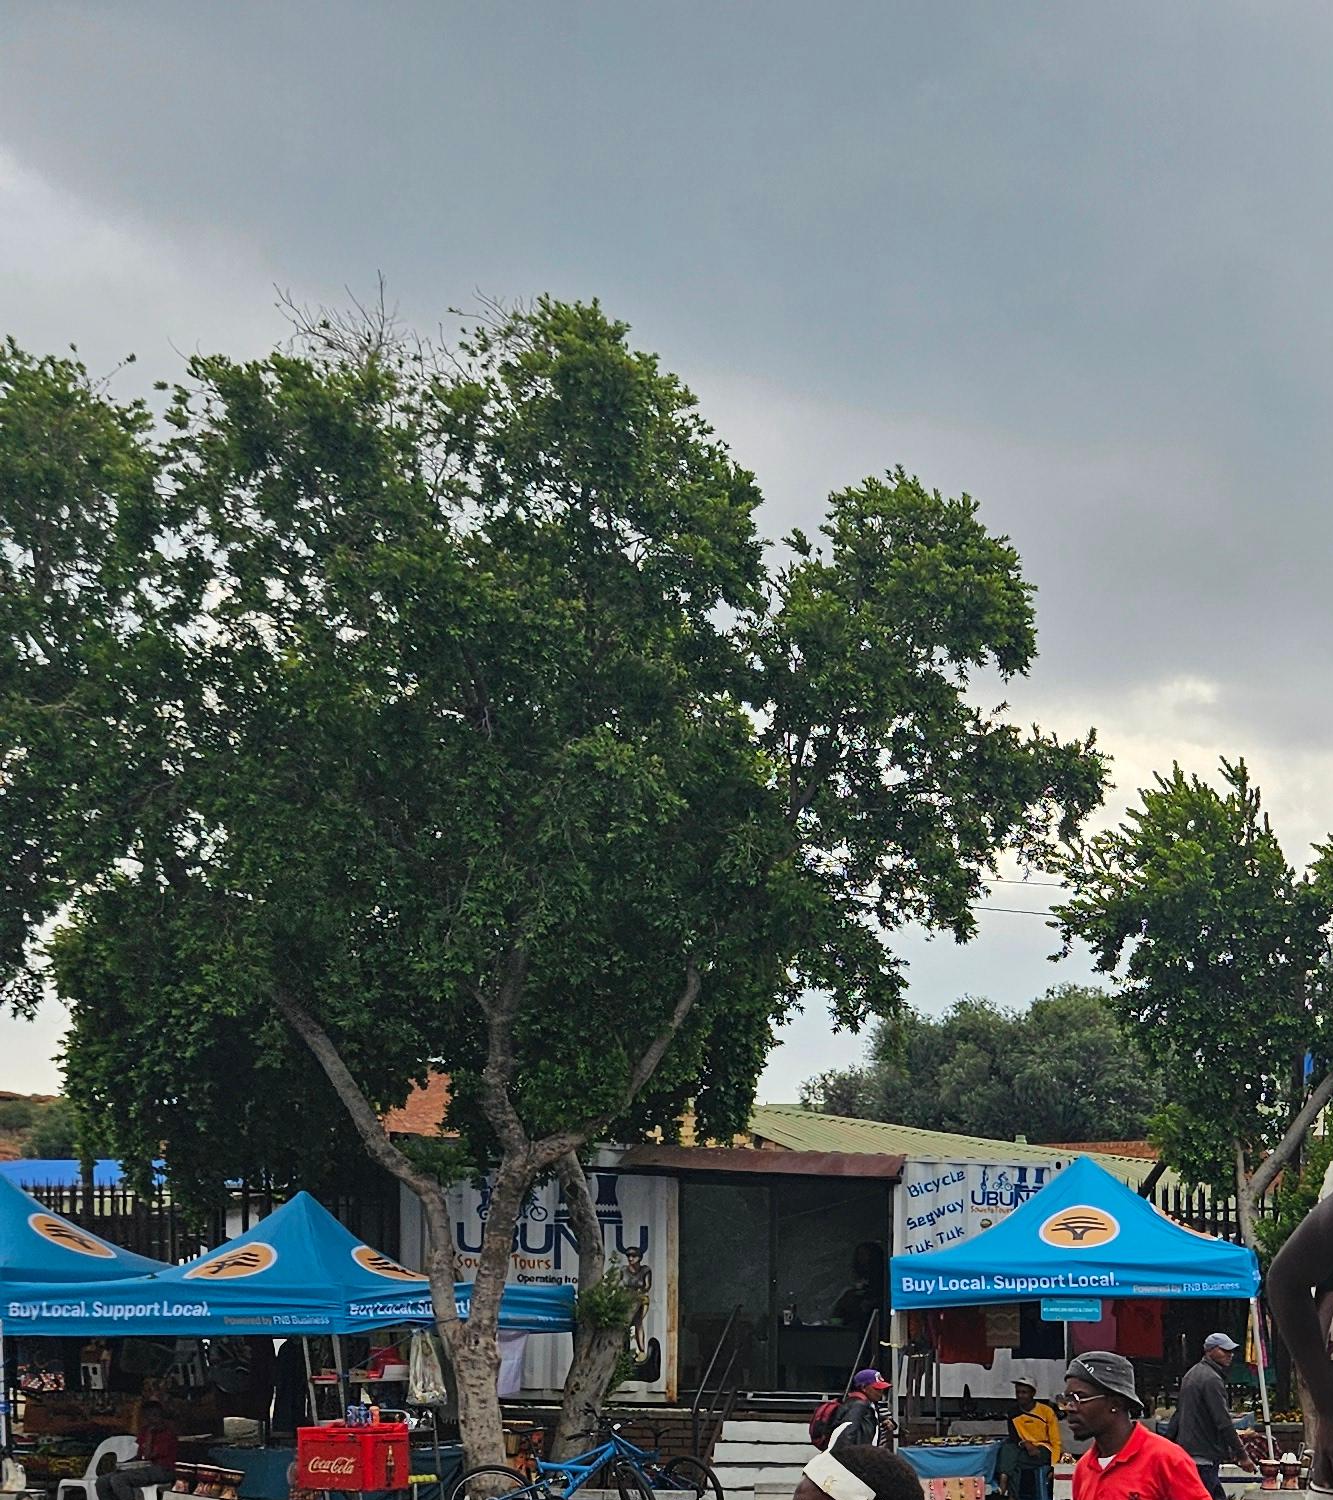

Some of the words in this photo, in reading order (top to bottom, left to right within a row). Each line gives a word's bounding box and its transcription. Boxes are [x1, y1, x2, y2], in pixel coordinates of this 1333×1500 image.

[907, 1170, 967, 1199] Bicycle
[971, 1190, 1036, 1209] UBUN
[906, 1198, 965, 1231] Segway
[904, 1239, 934, 1256] Tuk
[936, 1225, 965, 1245] Tuk
[511, 1254, 551, 1270] Tours
[517, 1274, 562, 1285] Operating
[564, 1274, 579, 1284] ho
[902, 1277, 936, 1295] Buy
[938, 1275, 990, 1291] Local.
[993, 1274, 1065, 1293] Support
[1068, 1272, 1120, 1288] Local.
[1183, 1283, 1201, 1292] FNB
[1202, 1282, 1240, 1291] Business
[8, 1302, 42, 1321] Buy
[42, 1301, 90, 1318] Local.
[92, 1301, 161, 1321] Support
[163, 1300, 212, 1318] Local.
[273, 1315, 291, 1325] FNB
